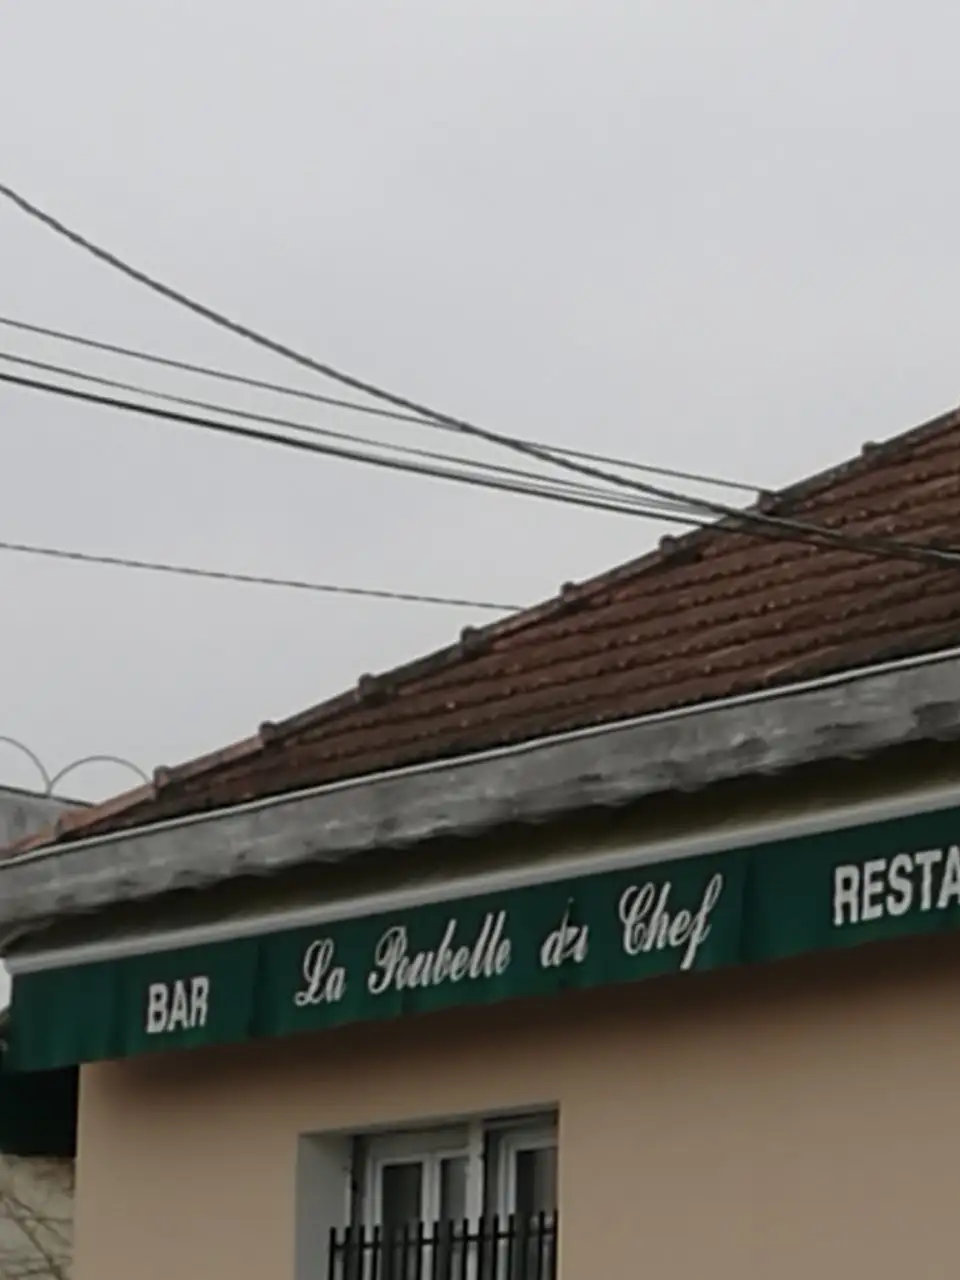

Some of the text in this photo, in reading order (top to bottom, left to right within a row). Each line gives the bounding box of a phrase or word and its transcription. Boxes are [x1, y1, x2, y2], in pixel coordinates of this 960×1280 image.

[295, 938, 347, 1007] La
[367, 910, 512, 995] Poubelle
[618, 873, 723, 971] Chef
[146, 975, 211, 1034] BAR
